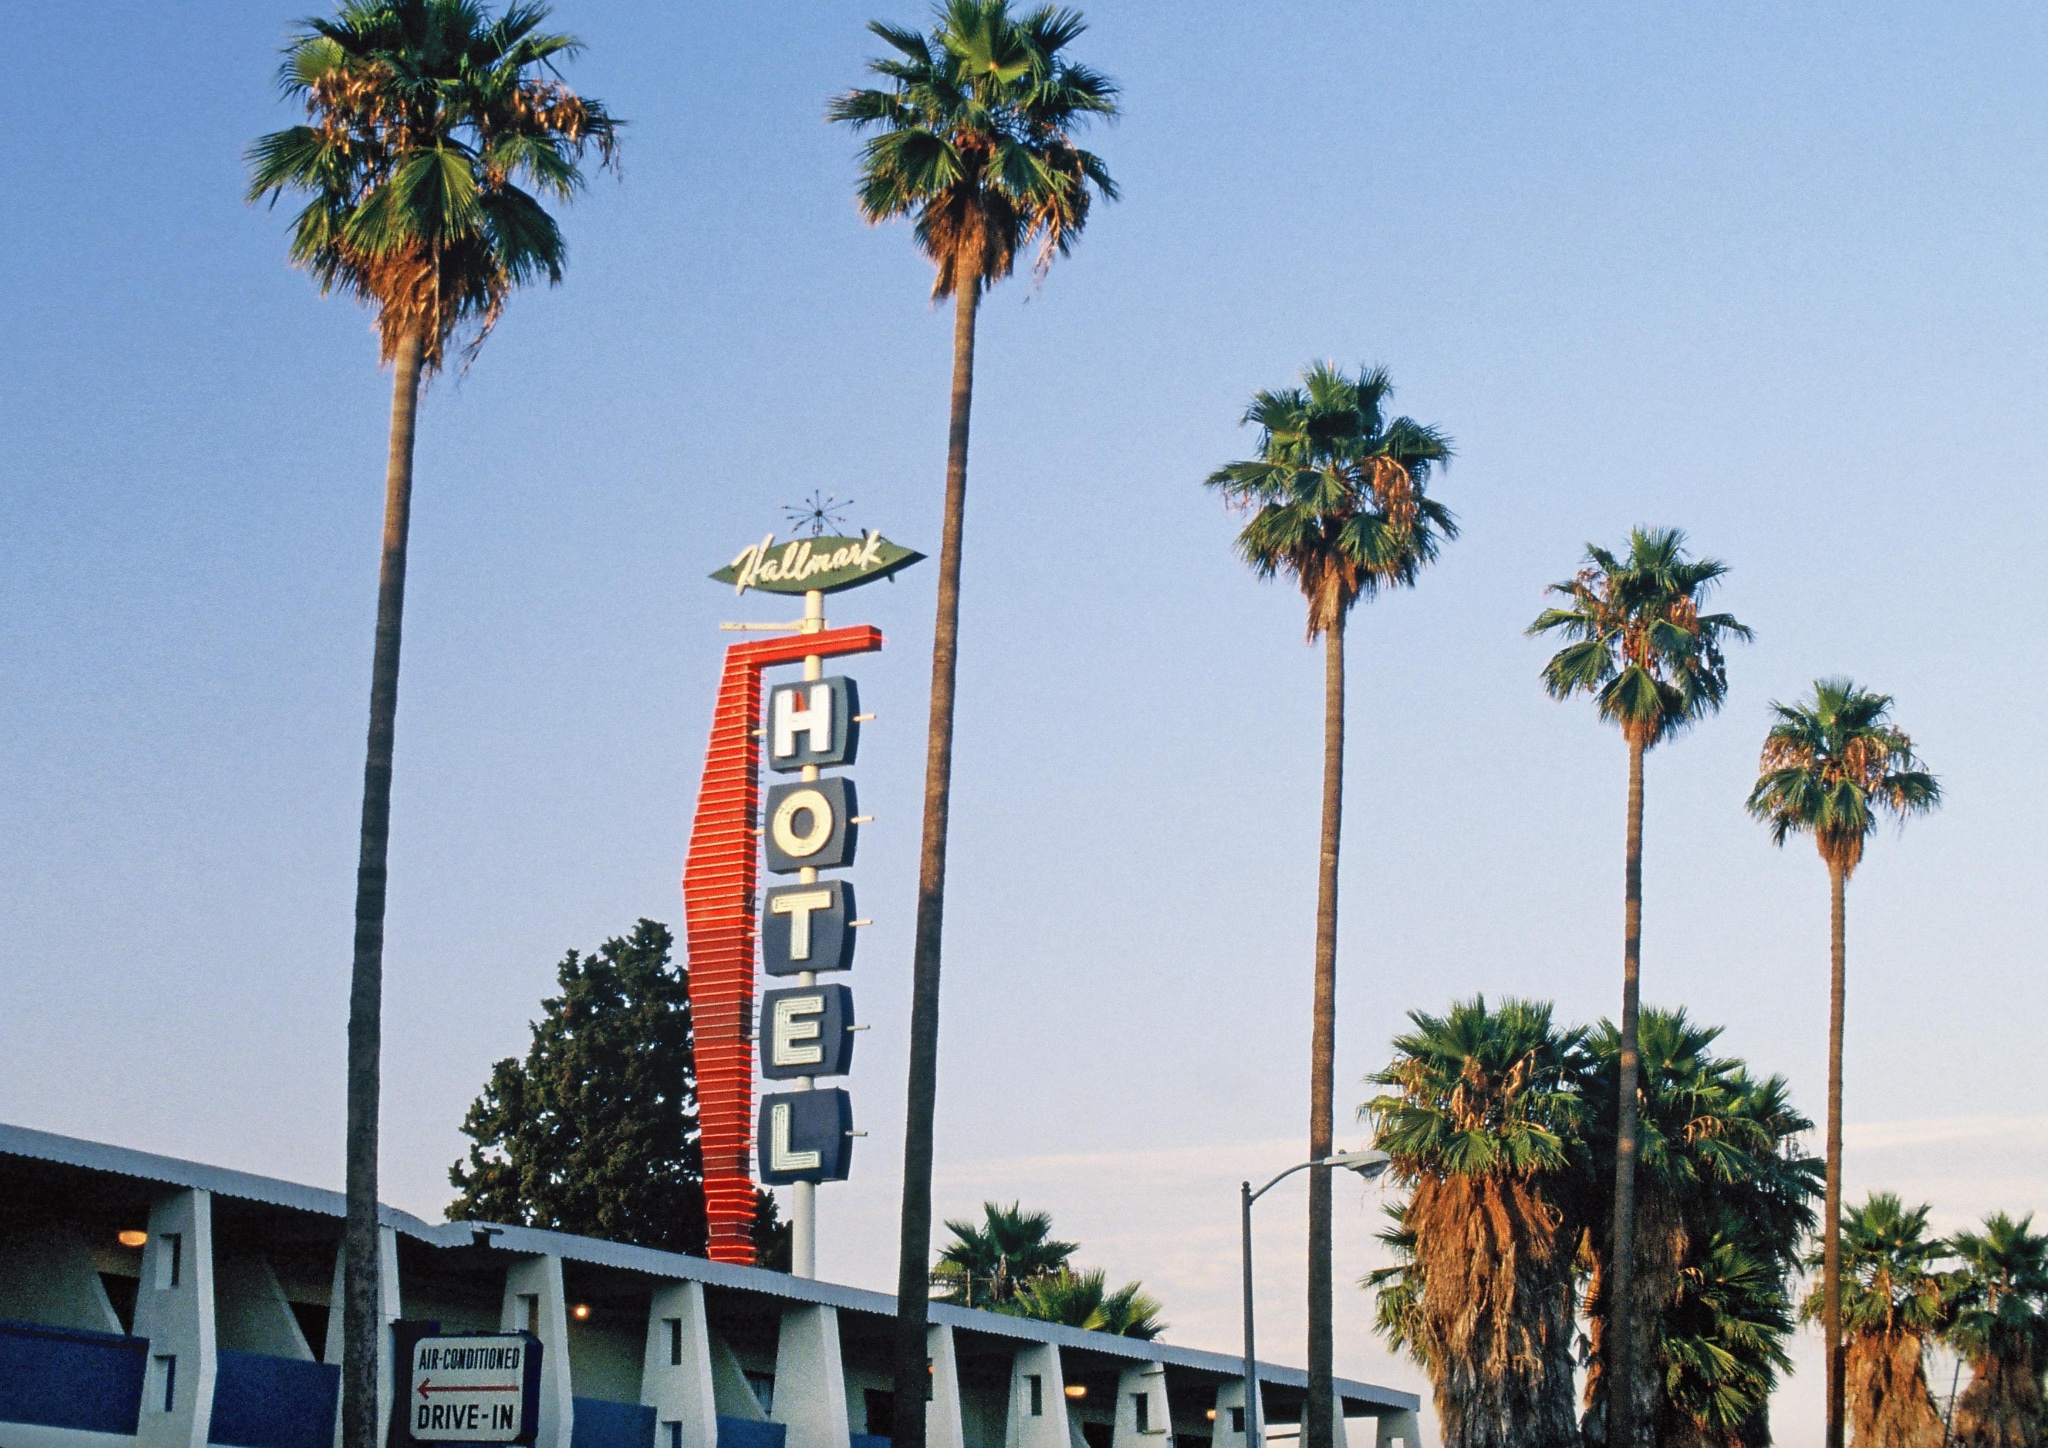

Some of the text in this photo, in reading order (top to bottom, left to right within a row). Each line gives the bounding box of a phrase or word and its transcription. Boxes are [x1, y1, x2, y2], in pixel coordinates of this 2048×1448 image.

[730, 529, 882, 595] Hallmark
[770, 683, 834, 1172] HOTEL
[418, 1347, 520, 1370] AIR-CONDITIONED
[417, 1404, 514, 1429] DRIVE-IN
